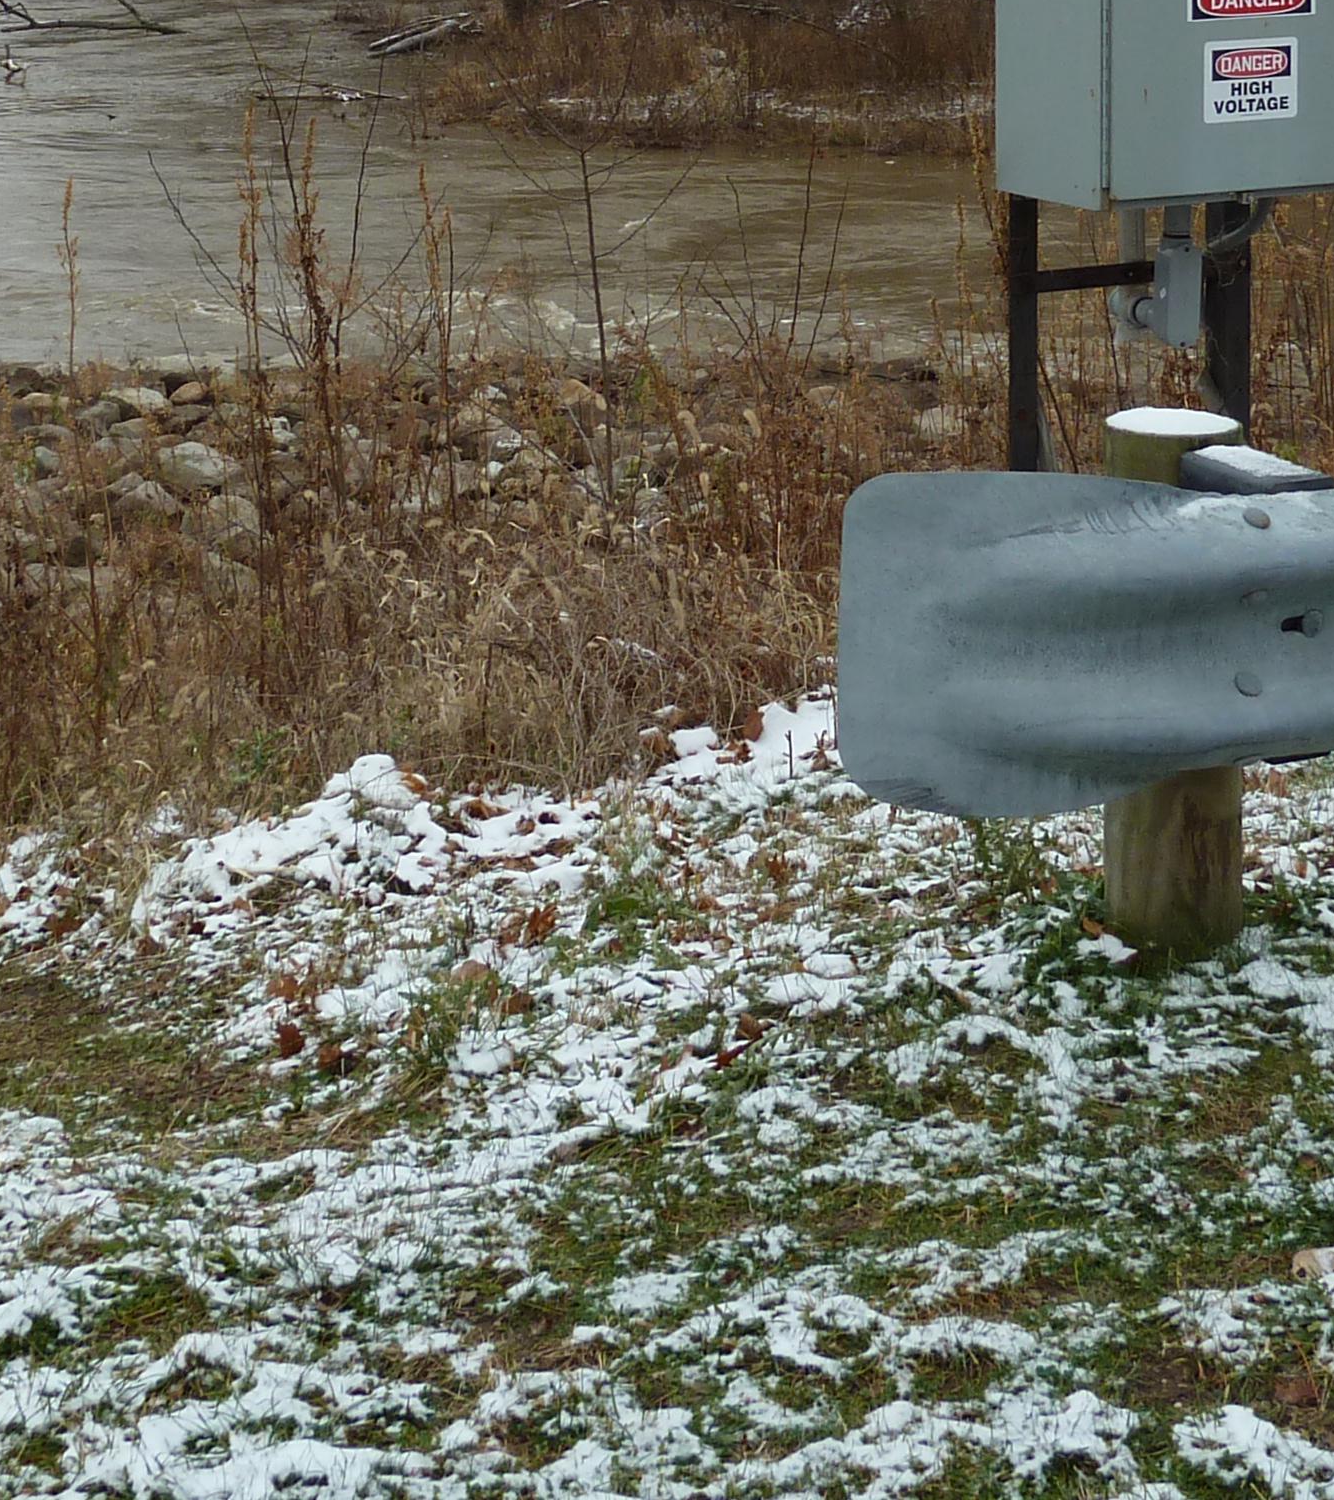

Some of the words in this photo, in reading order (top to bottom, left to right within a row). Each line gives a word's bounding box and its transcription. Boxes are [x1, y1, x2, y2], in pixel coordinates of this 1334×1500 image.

[1221, 53, 1283, 73] DANGER
[1230, 80, 1273, 96] HIGH
[1214, 96, 1289, 114] VOLTAGE
